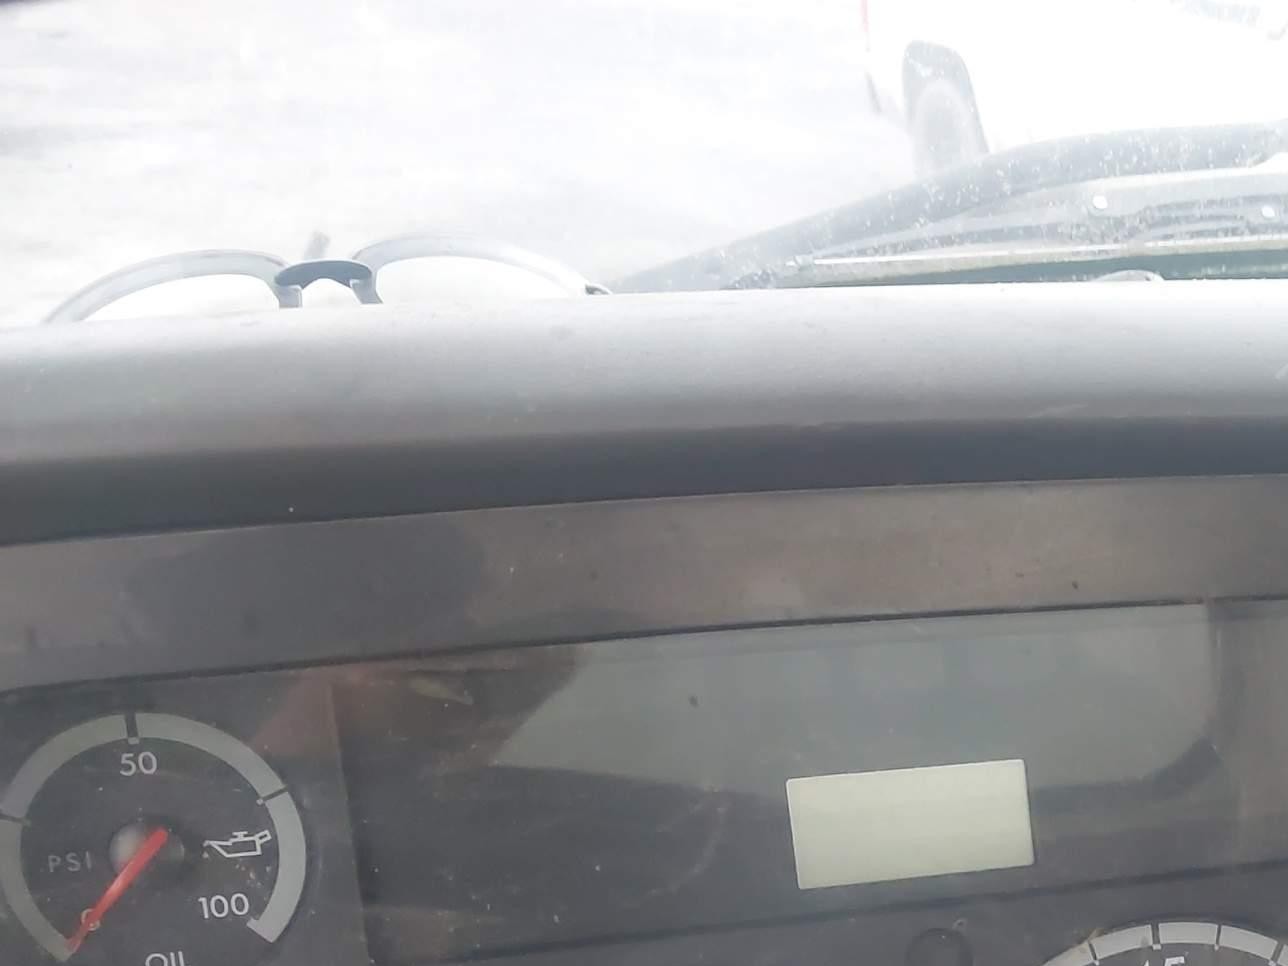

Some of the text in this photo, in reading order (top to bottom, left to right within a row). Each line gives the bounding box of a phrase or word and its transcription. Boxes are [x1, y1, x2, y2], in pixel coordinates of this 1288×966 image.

[119, 751, 157, 777] 50
[48, 850, 92, 873] PSI
[198, 893, 249, 919] 100
